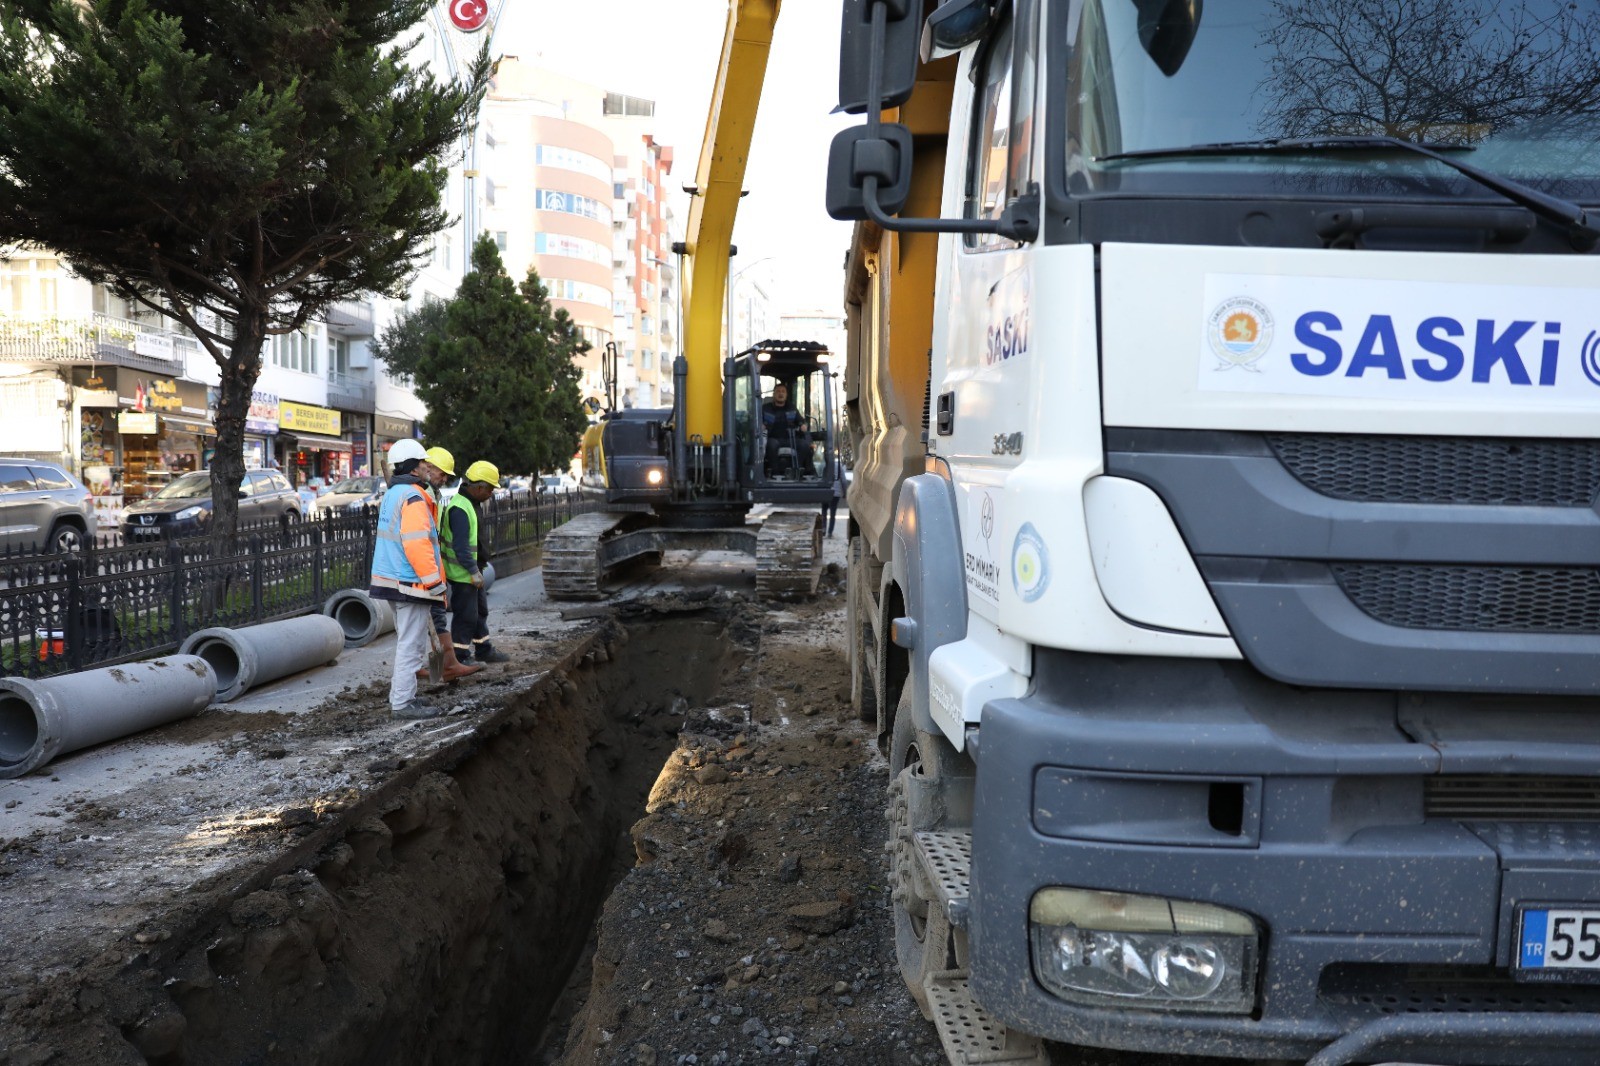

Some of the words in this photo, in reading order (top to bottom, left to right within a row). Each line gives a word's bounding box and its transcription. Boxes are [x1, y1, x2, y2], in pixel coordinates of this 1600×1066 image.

[296, 408, 314, 419] BEREN
[308, 421, 329, 431] MARKET
[1550, 917, 1600, 962] 55
[1525, 942, 1543, 957] TR
[1526, 974, 1563, 982] ANKARA
